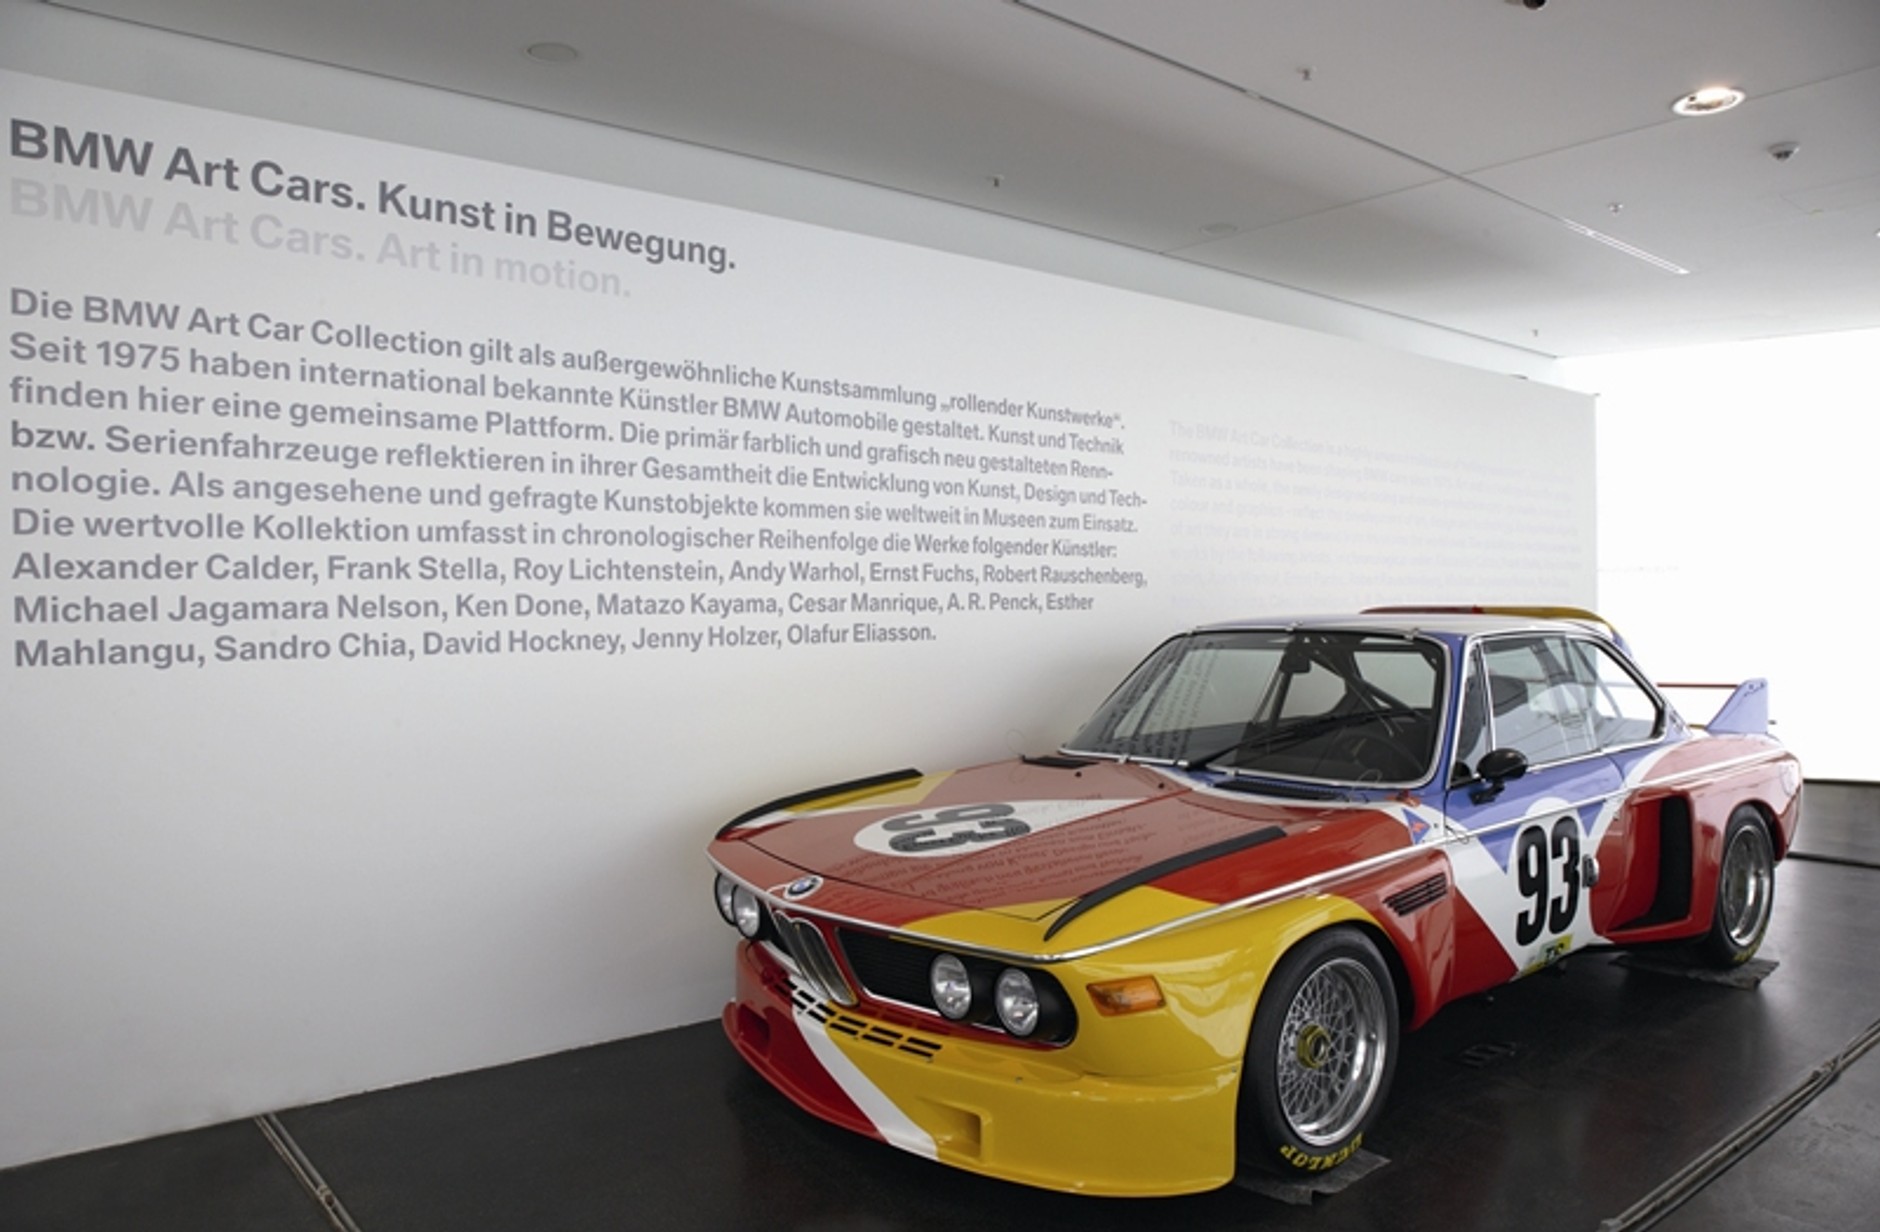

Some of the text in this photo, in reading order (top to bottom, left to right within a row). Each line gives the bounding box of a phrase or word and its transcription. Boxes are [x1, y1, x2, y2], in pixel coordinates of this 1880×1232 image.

[10, 118, 736, 274] BMW Art Cars. Kunst in Bewegung.
[11, 177, 631, 298] BMW Art Cars. Art in motion.
[10, 332, 1124, 454] Seit 1975 haben international bekannte Künstler BMW Automobile gestaltet. Kunst und Technik
[11, 287, 73, 321] Die
[84, 295, 180, 330] BMW
[187, 307, 240, 337] Art
[247, 313, 305, 342] Car
[311, 320, 462, 358] Collection
[469, 338, 513, 366] gilt
[518, 343, 556, 368] als
[561, 350, 777, 390] außergewöhnliche
[782, 370, 936, 412] Kunstsammlung
[9, 376, 1113, 478] finden hier eine gemeinsame Plattform. Die primär farblich und grafisch neu gestalteten Renn-
[11, 419, 1147, 507] bzw. Serienfahrzeuge reflektieren in ihrer Gesamtheit die Entwicklung von Kunst, Design und Tech-
[12, 465, 1138, 532] nologie. Als angesehene und gefragte Kunstobjekte kommen sie weltweit in Museen zum Einsatz.
[13, 508, 1117, 559] Die wertvolle Kollektion umfasst in chronologischer Reihenfolge die Werke folgender Künstler:
[12, 552, 199, 580] Alexander
[205, 553, 319, 586] Calder,
[328, 555, 412, 580] Frank
[418, 555, 506, 586] Stella,
[514, 557, 564, 586] Roy
[569, 558, 724, 586] Lichtenstein,
[729, 560, 786, 586] Andy
[789, 561, 865, 586] Warhol,
[869, 562, 919, 582] Ernst
[922, 562, 979, 586] Fuchs,
[983, 564, 1037, 583] Robert
[1040, 565, 1147, 588] Rauschenberg,
[14, 592, 1094, 627] Michael Jagamara Nelson, Ken Done, Matazo Kayama, Cesar Manrique, A. R. Penck, Esther
[15, 623, 936, 670] Mahlangu, Sandro Chia, David Hockney, Jenny Holzer, Olafur Eliasson.
[1515, 815, 1580, 946] 93
